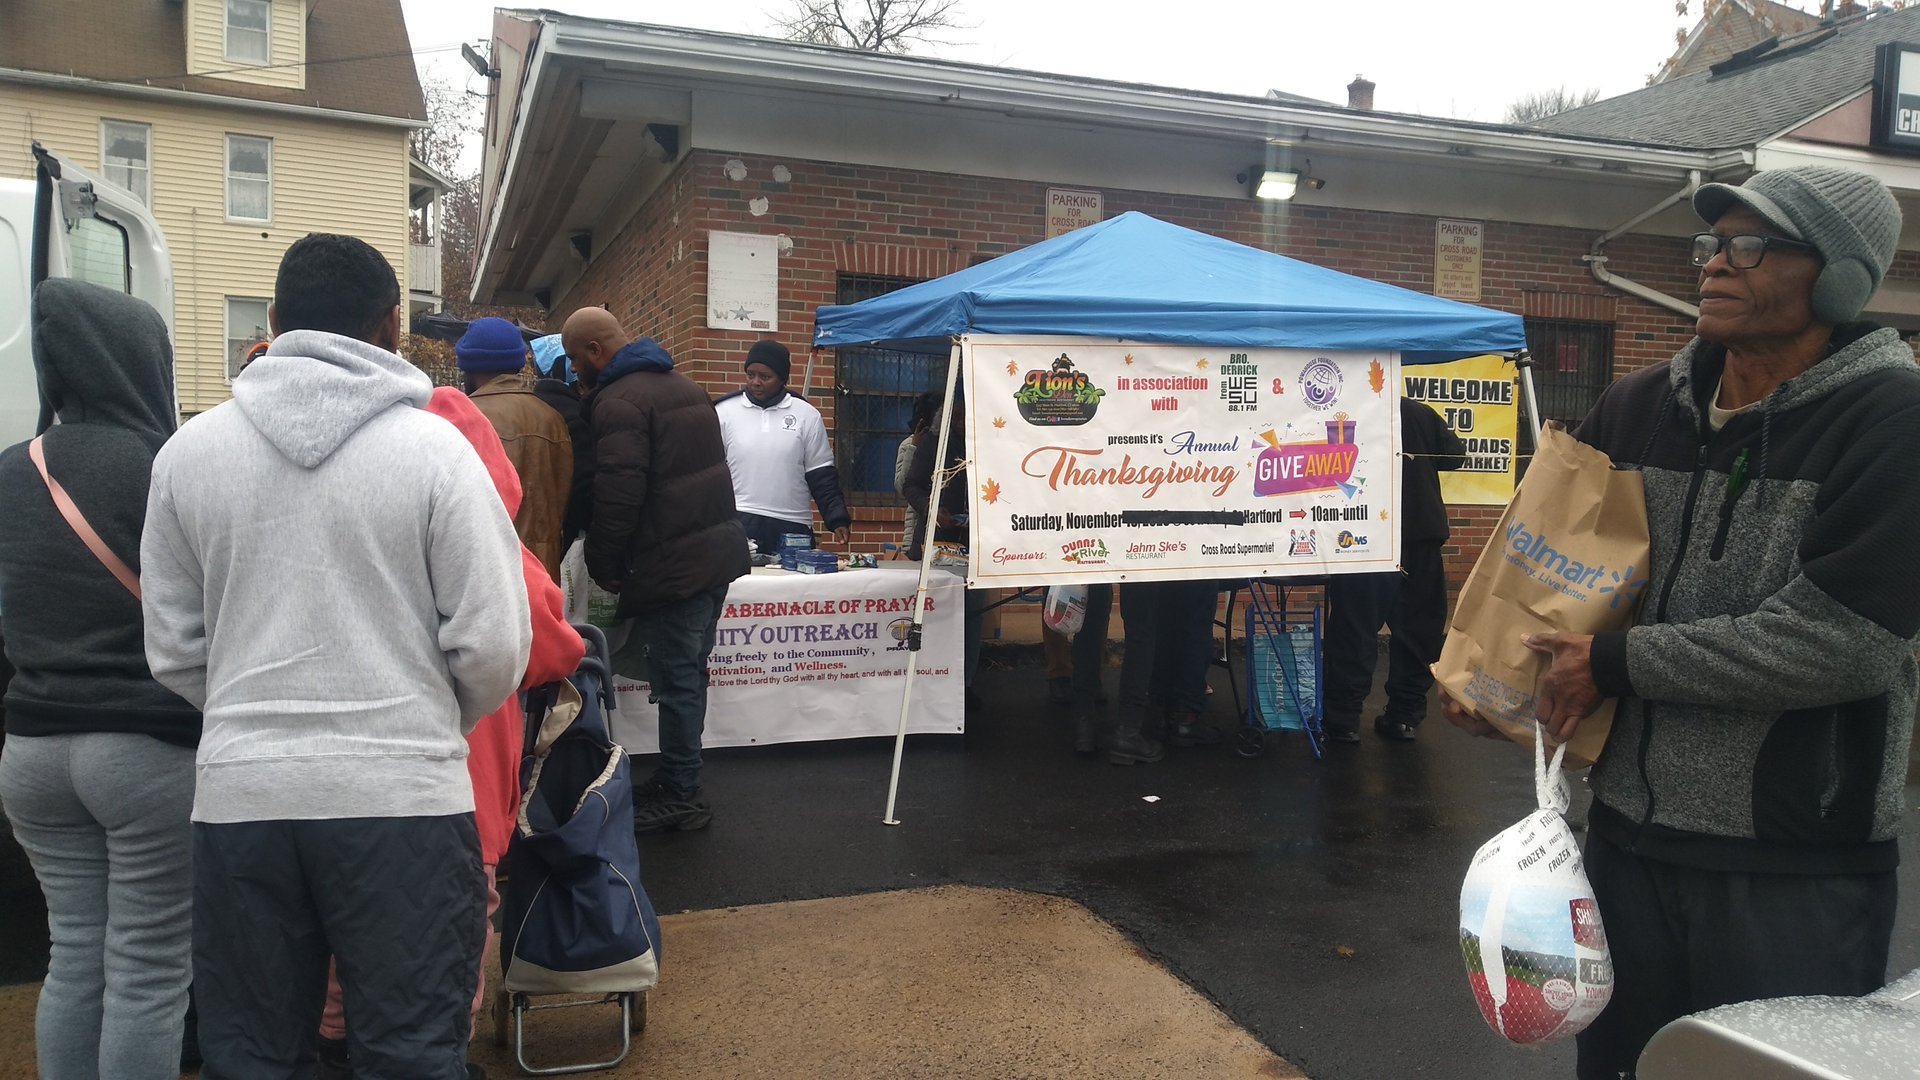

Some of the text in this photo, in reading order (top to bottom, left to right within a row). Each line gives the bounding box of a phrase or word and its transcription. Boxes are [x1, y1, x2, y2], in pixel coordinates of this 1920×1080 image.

[1052, 194, 1097, 208] PARKING
[1067, 207, 1081, 217] FOR
[1052, 217, 1075, 227] CROSS
[1441, 223, 1478, 236] PARKING
[1453, 236, 1465, 244] FOR
[1440, 244, 1477, 255] CROSS ROAD
[1230, 353, 1250, 364] BRO.
[1317, 357, 1341, 374] FOUNDATION
[1220, 364, 1258, 375] DERRICK
[1024, 370, 1087, 398] Lion's
[1117, 375, 1208, 391] in association
[1220, 380, 1228, 400] from
[1272, 377, 1285, 395] &
[1404, 376, 1513, 404] WELCOME
[1150, 396, 1179, 411] with
[1246, 404, 1257, 412] FM
[1444, 407, 1474, 431] TO
[1107, 430, 1240, 456] presents it's Annual
[1020, 445, 1241, 499] Thanksgiving
[1259, 451, 1354, 481] GIVEAWAY
[1011, 512, 1064, 532] Saturday,
[1066, 511, 1123, 528] November
[1243, 509, 1282, 524] Hartford
[1310, 504, 1369, 522] 10am-until
[1079, 547, 1110, 559] River
[1125, 540, 1187, 553] Jahm Ske's
[1201, 541, 1275, 556] Cross Road Supermarket
[991, 547, 1048, 566] Sponsors:
[1125, 551, 1166, 560] RESTAURANT
[1538, 572, 1561, 591] Live
[1561, 584, 1587, 602] better.
[722, 595, 935, 618] ABERNACLE OF PRAYR
[760, 622, 878, 644] OUTREACH
[735, 651, 768, 663] freely
[773, 650, 785, 660] to
[787, 649, 805, 659] the
[771, 663, 792, 673] and
[794, 661, 847, 671] Wellness.
[718, 679, 734, 687] love
[736, 678, 748, 686] the
[750, 677, 768, 685] Lord
[769, 677, 781, 686] thy
[783, 675, 799, 683] God
[800, 674, 815, 682] with
[816, 673, 826, 681] all
[827, 673, 839, 682] thy
[840, 671, 860, 680] heart,
[861, 670, 876, 678] and
[877, 669, 892, 678] with
[893, 668, 903, 676] all
[916, 668, 934, 677] soul,
[935, 667, 949, 676] and
[617, 683, 635, 692] said
[1517, 845, 1547, 871] FROZEN
